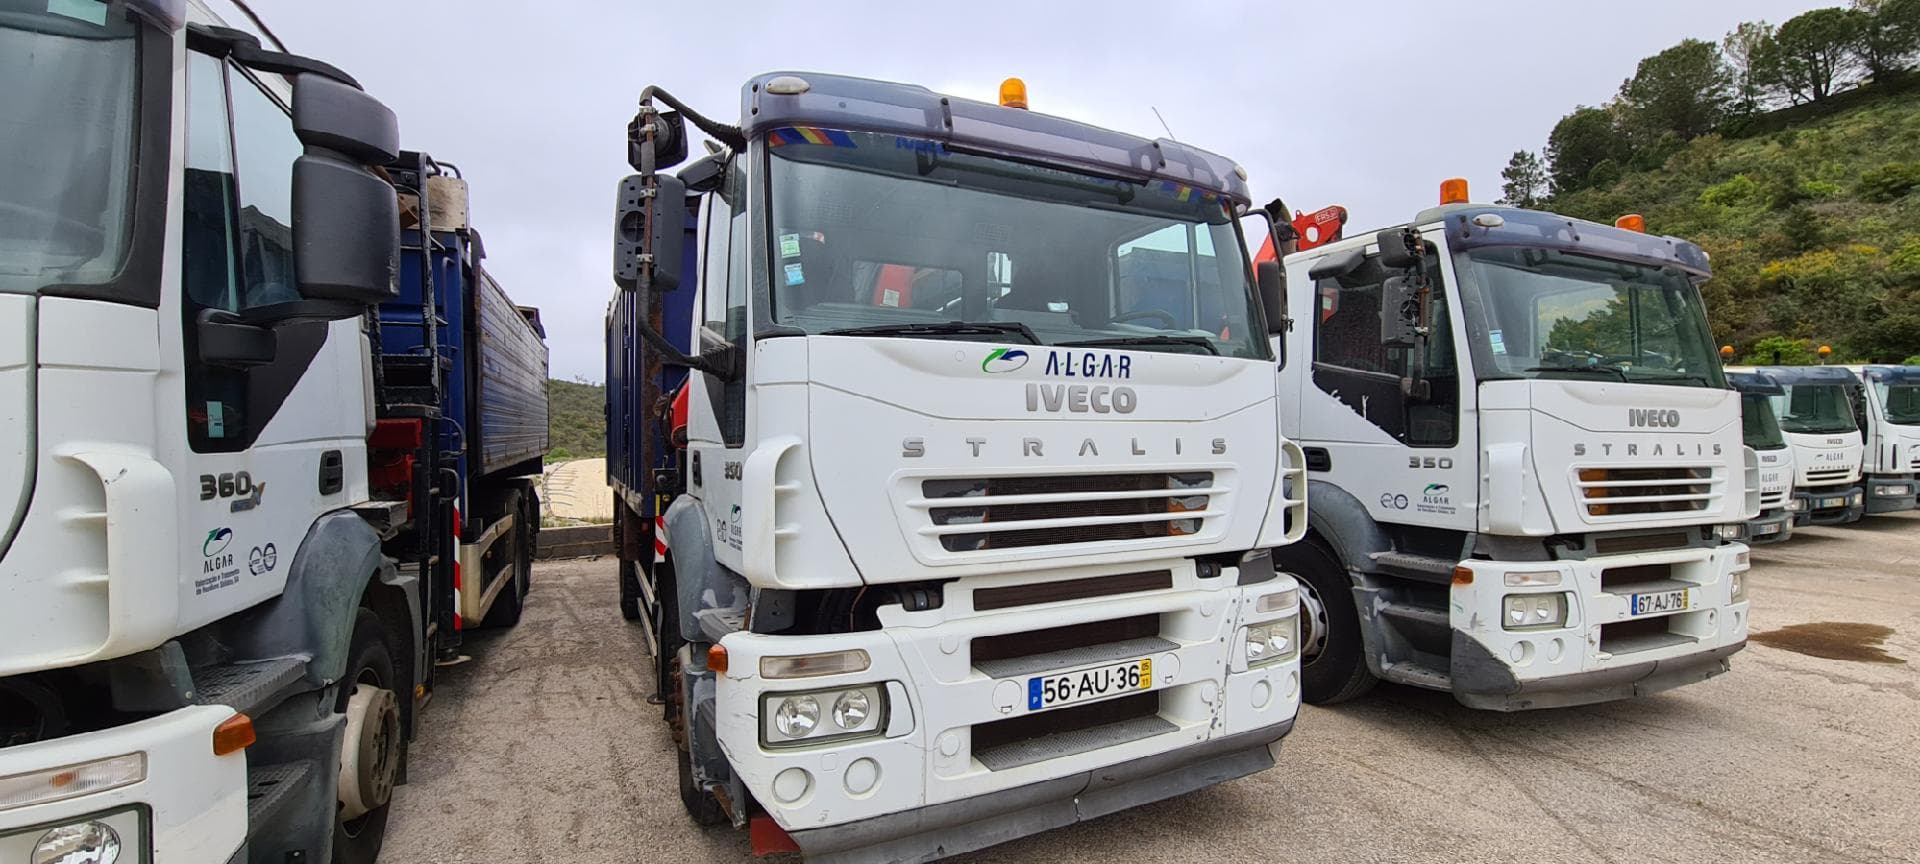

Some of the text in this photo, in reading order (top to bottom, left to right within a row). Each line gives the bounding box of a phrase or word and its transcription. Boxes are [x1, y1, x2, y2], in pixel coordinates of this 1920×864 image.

[1026, 383, 1137, 414] IVECO
[1629, 409, 1680, 427] IVECO
[902, 437, 1227, 457] STRALIS
[1574, 444, 1721, 456] STRALIS
[1409, 456, 1453, 469] 350
[200, 471, 252, 501] 360
[1423, 496, 1449, 504] ALGAR
[203, 554, 233, 574] ALGAR
[1141, 662, 1149, 671] 05
[1142, 678, 1149, 686] 11
